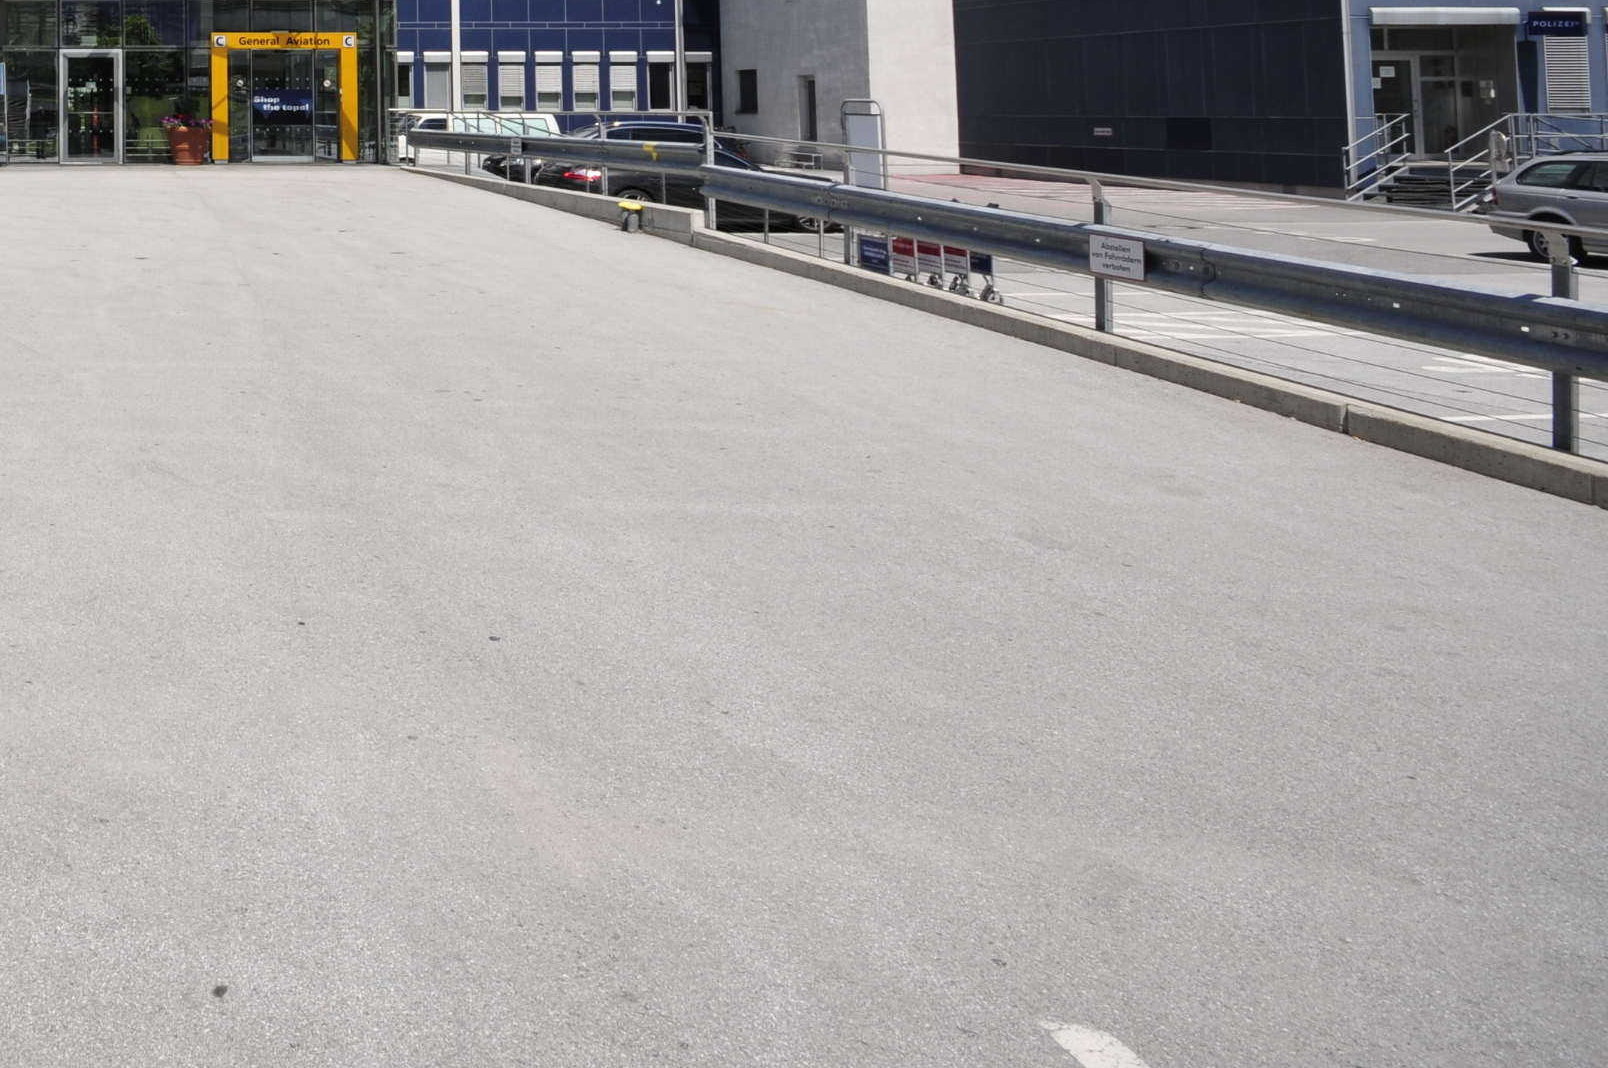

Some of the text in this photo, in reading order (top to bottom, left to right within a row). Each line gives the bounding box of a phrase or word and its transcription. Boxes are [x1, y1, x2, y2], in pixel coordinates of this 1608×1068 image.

[1532, 20, 1574, 28] POLIZEI
[215, 37, 225, 47] C
[238, 36, 330, 46] General Aviation
[344, 36, 353, 47] C
[253, 95, 280, 104] Shop
[263, 103, 309, 112] the tops!
[1101, 242, 1131, 253] Abstellen
[1104, 252, 1142, 264] Fahrrädern
[1102, 262, 1131, 272] verboten
